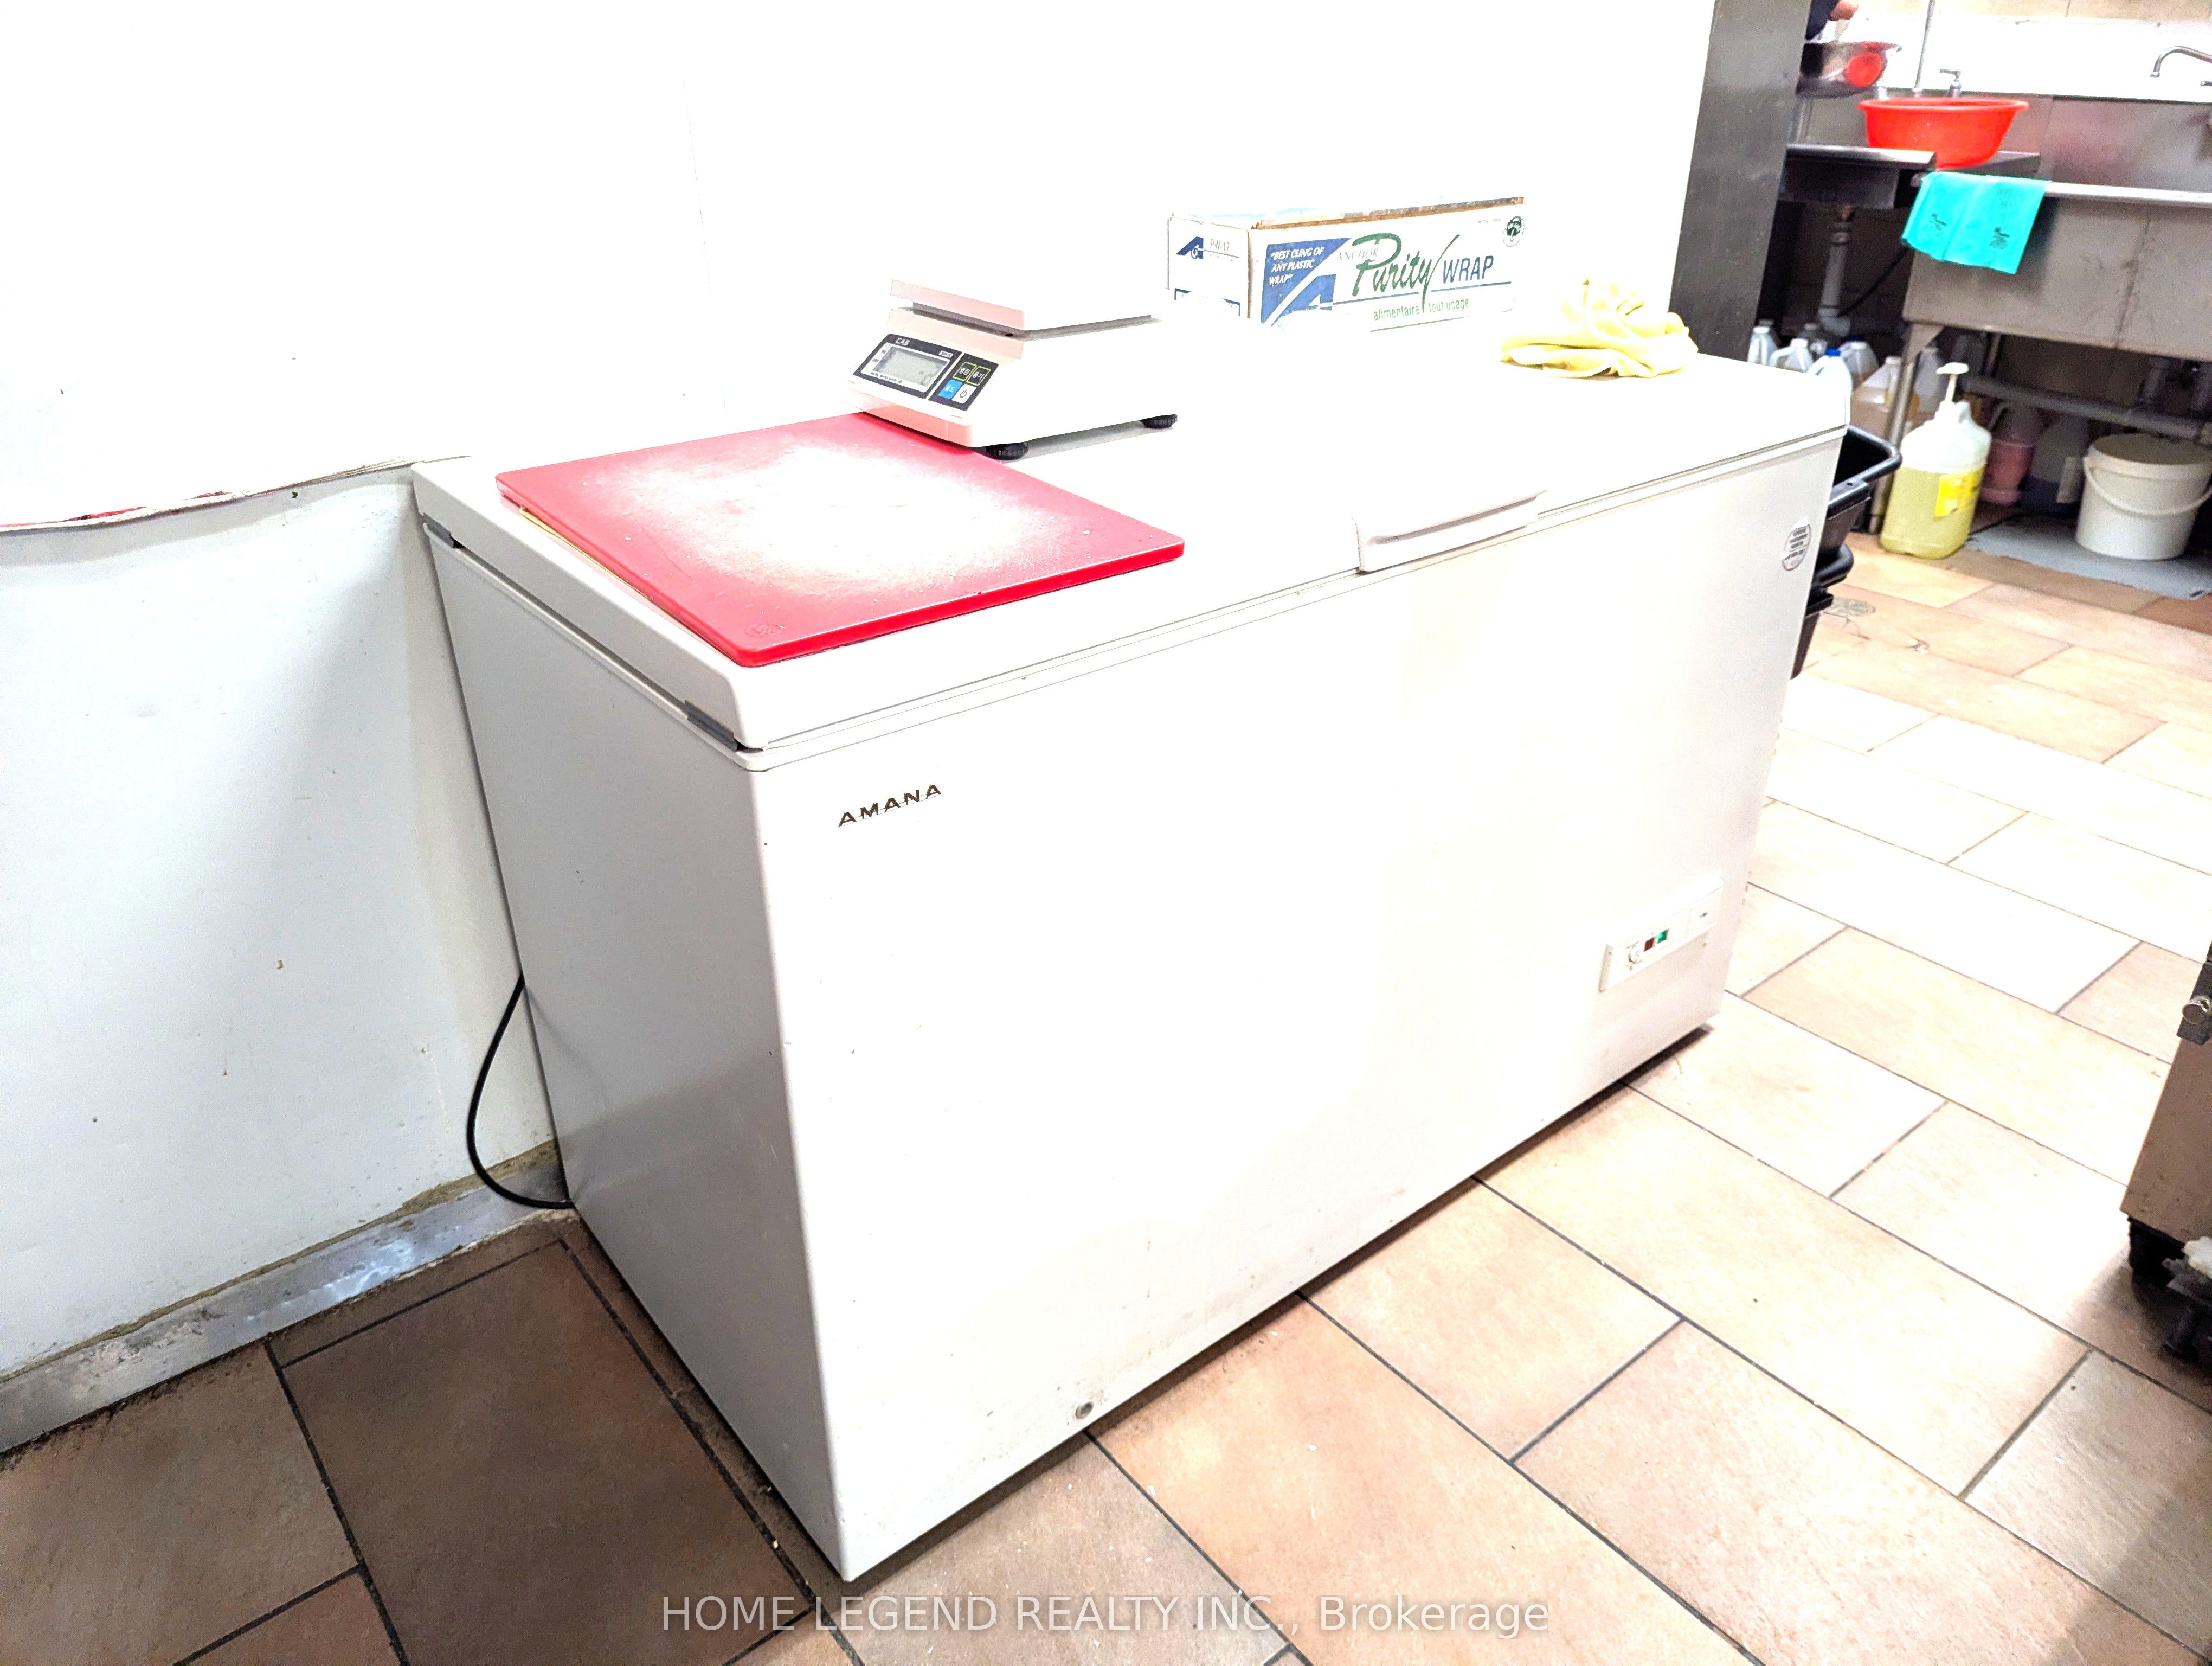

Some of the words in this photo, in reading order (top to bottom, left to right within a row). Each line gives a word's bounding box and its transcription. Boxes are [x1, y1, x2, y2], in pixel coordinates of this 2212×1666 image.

[1290, 248, 1313, 258] CLING
[1313, 247, 1324, 255] OF
[1336, 248, 1379, 260] ANCHOR
[1271, 262, 1285, 272] ANY
[1287, 260, 1315, 271] PLASTIC
[1352, 233, 1460, 314] Purity
[1443, 255, 1494, 284] WRAP
[1373, 305, 1420, 321] alimentaire
[1429, 302, 1444, 312] tout
[1446, 298, 1469, 311] usage
[896, 338, 910, 346] CAS
[838, 785, 941, 828] AMANA
